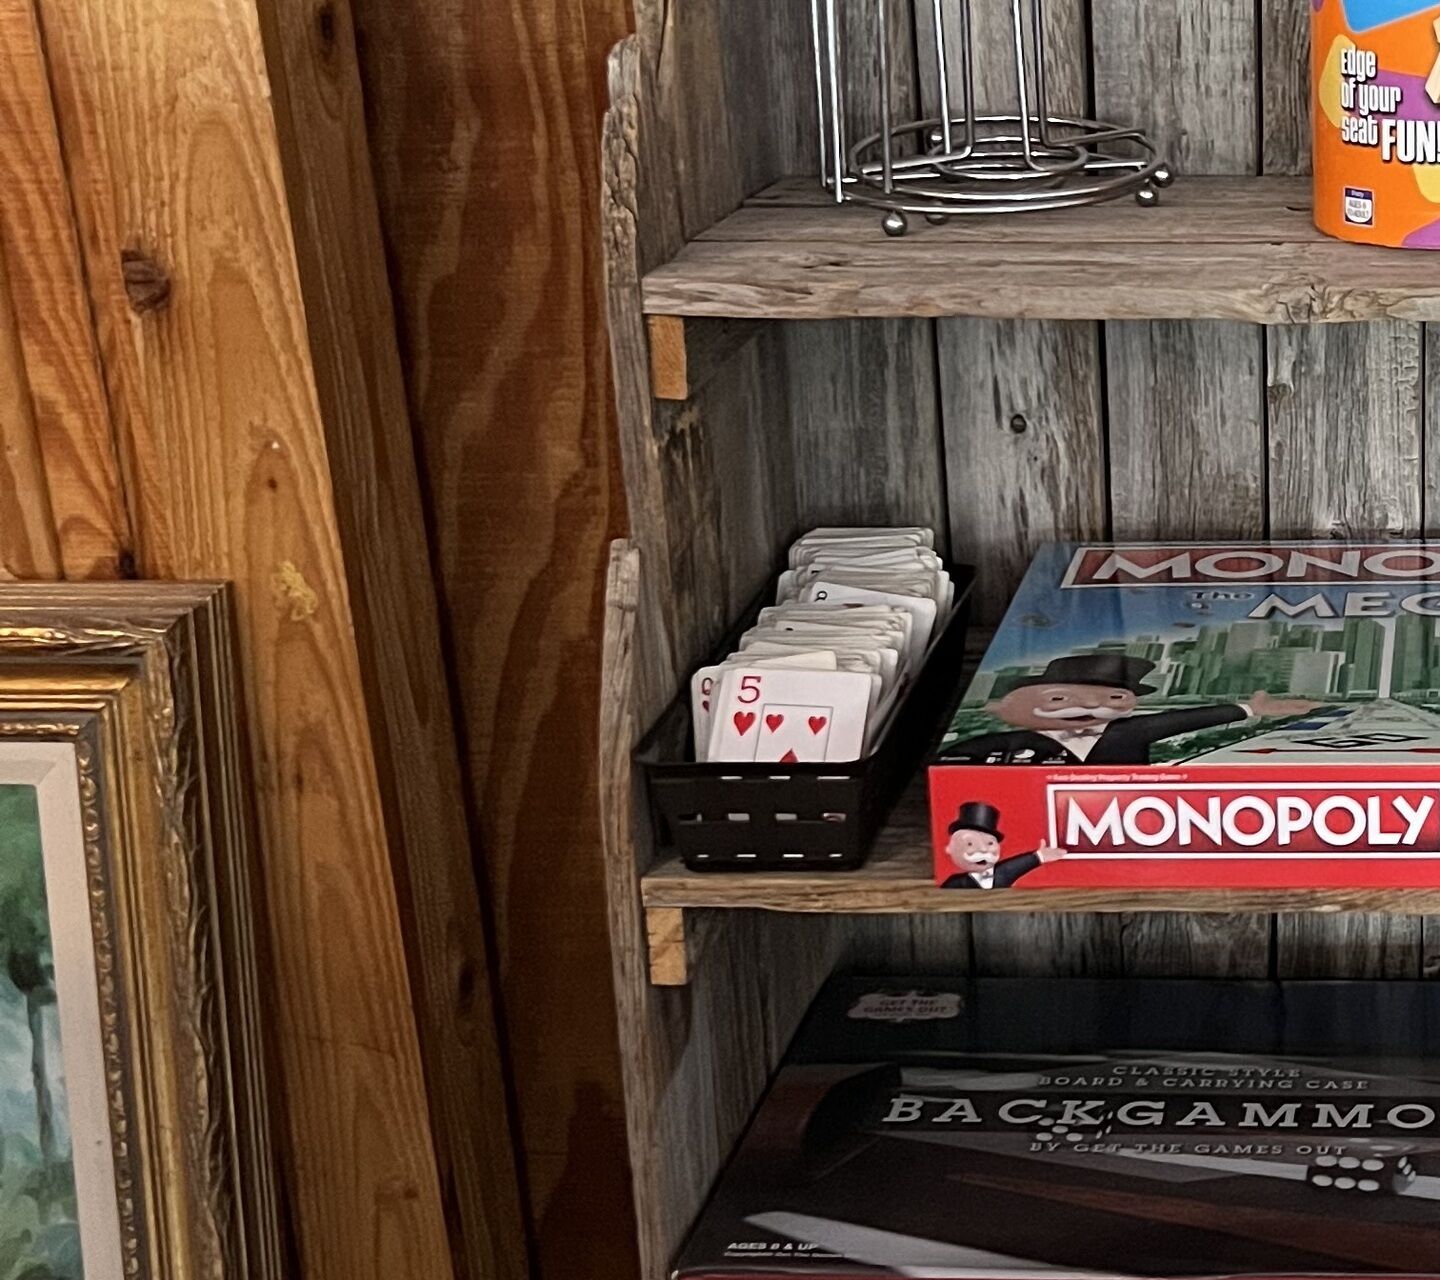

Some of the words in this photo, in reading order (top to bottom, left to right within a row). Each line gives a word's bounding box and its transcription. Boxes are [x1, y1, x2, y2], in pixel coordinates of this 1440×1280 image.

[1341, 48, 1377, 82] Edge
[1341, 77, 1356, 109] of
[1358, 84, 1402, 116] your
[1341, 115, 1378, 145] seat
[737, 675, 763, 704] 5
[1065, 795, 1436, 847] MONOPOLY
[1038, 1076, 1123, 1087] BOARD
[1136, 1076, 1149, 1087] &
[1163, 1077, 1293, 1089] CARRYING
[1305, 1080, 1369, 1090] CASE
[1112, 1065, 1217, 1076] CLASSIC
[1229, 1068, 1301, 1078] STYLE
[1030, 1142, 1061, 1152] BY
[1073, 1143, 1122, 1153] GET
[1134, 1144, 1182, 1154] THE
[1194, 1144, 1283, 1154] GAMES
[1296, 1145, 1348, 1155] OUT
